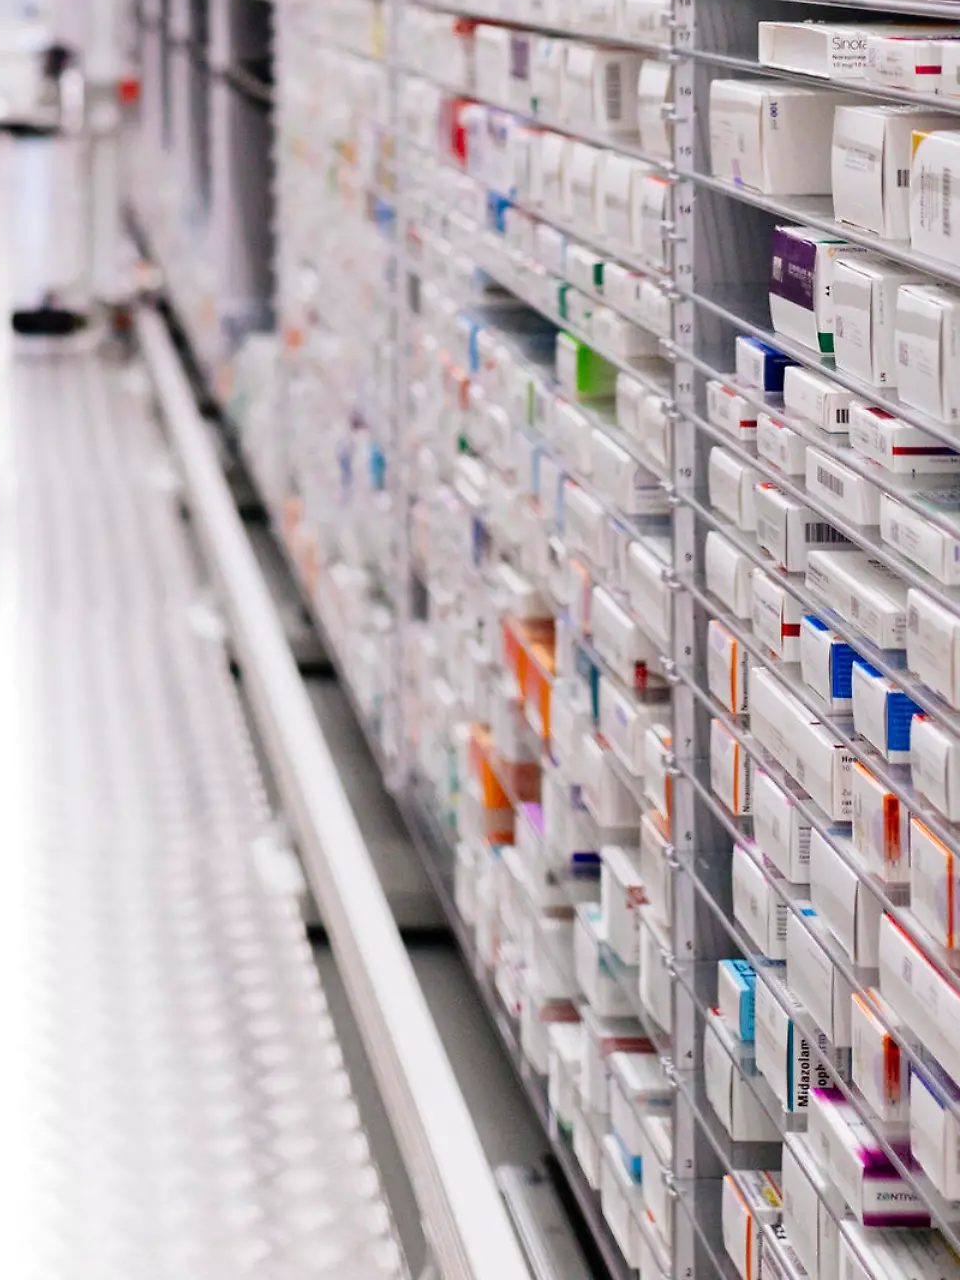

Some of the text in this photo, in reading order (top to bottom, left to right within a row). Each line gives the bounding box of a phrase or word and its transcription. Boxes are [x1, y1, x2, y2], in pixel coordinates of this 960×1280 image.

[679, 32, 691, 41] 17
[679, 87, 692, 96] 16
[679, 147, 692, 156] 15
[679, 205, 691, 214] 14
[679, 265, 691, 274] 13
[680, 324, 691, 334] 12
[679, 383, 690, 392] 11
[679, 468, 692, 478] 10
[685, 552, 692, 562] 9
[685, 1050, 692, 1059] 4
